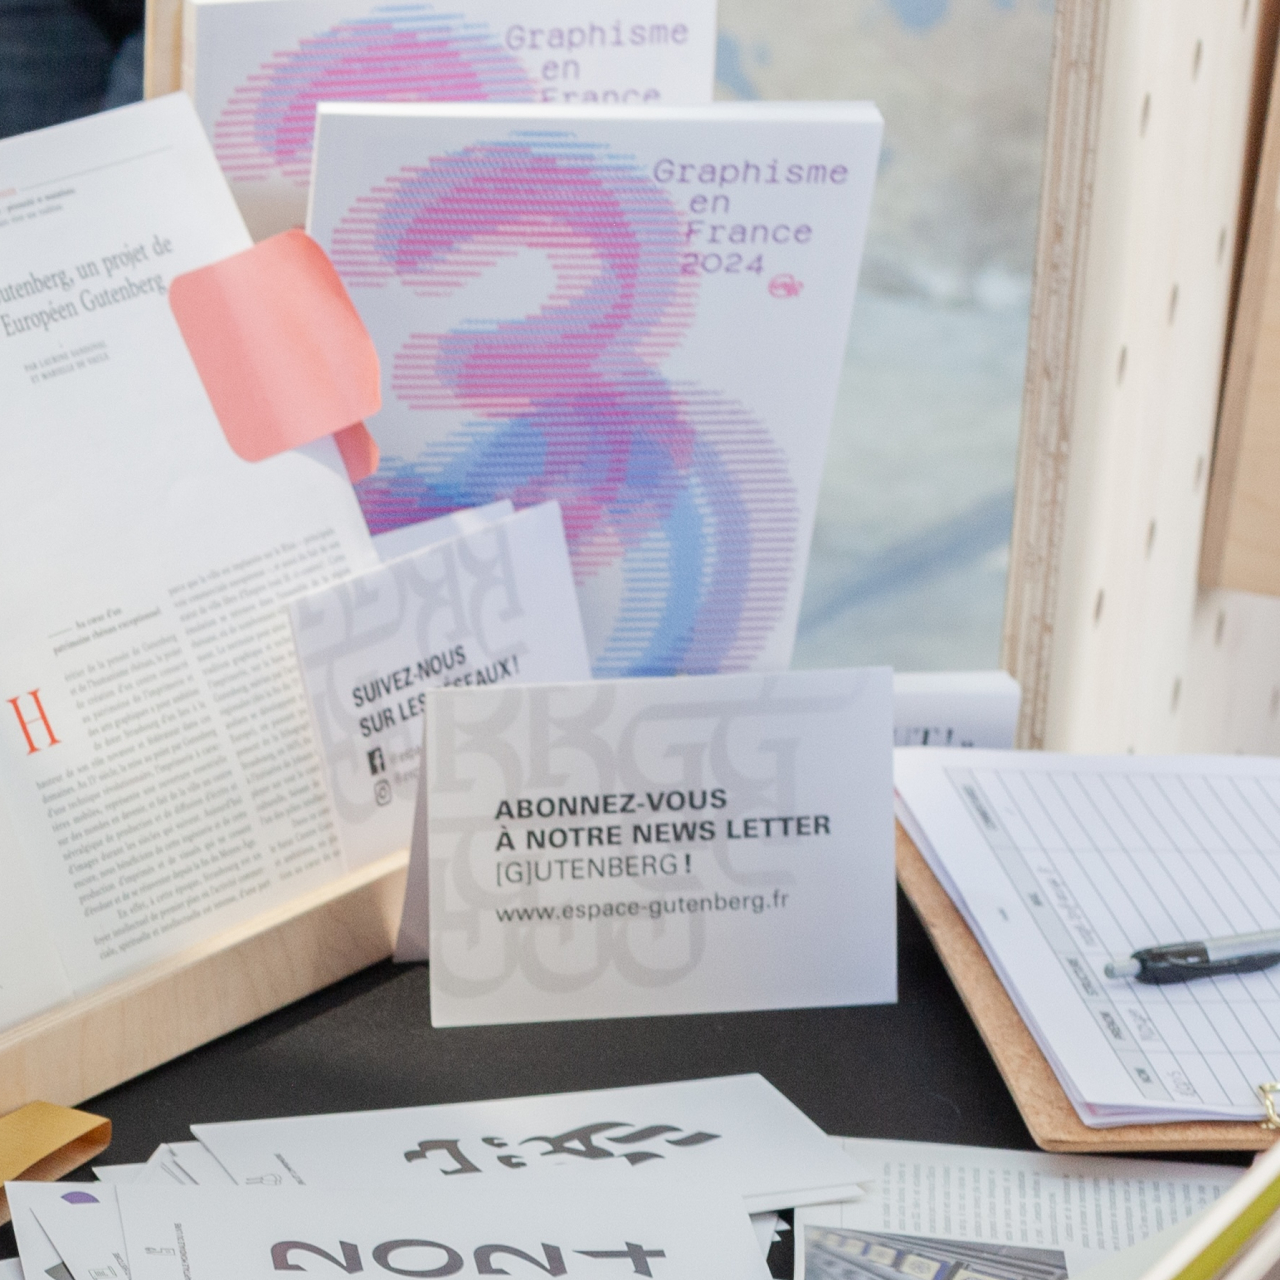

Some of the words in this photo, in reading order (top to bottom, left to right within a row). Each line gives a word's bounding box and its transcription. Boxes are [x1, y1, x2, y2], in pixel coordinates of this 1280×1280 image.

[505, 22, 689, 51] Graphisme
[541, 58, 581, 81] en
[541, 87, 662, 103] France
[652, 158, 849, 188] Graphisme
[688, 193, 731, 214] en
[684, 219, 813, 245] France
[76, 258, 100, 282] un
[101, 245, 149, 282] projet
[151, 233, 174, 259] de
[680, 252, 764, 275] 2024
[0, 299, 80, 339] Européen
[79, 272, 168, 317] Gutenberg
[352, 644, 468, 708] SUIVEZ-NOUS
[359, 708, 397, 738] SUR
[398, 692, 426, 723] LES
[494, 788, 728, 821] ABONNEZ-VOUS
[495, 820, 516, 852] À
[526, 825, 623, 850] NOTRE
[632, 820, 716, 846] NEWS
[725, 814, 832, 841] LETTER
[495, 889, 790, 924] www.espace-gutenberg.fr
[270, 1238, 667, 1279] 2024
